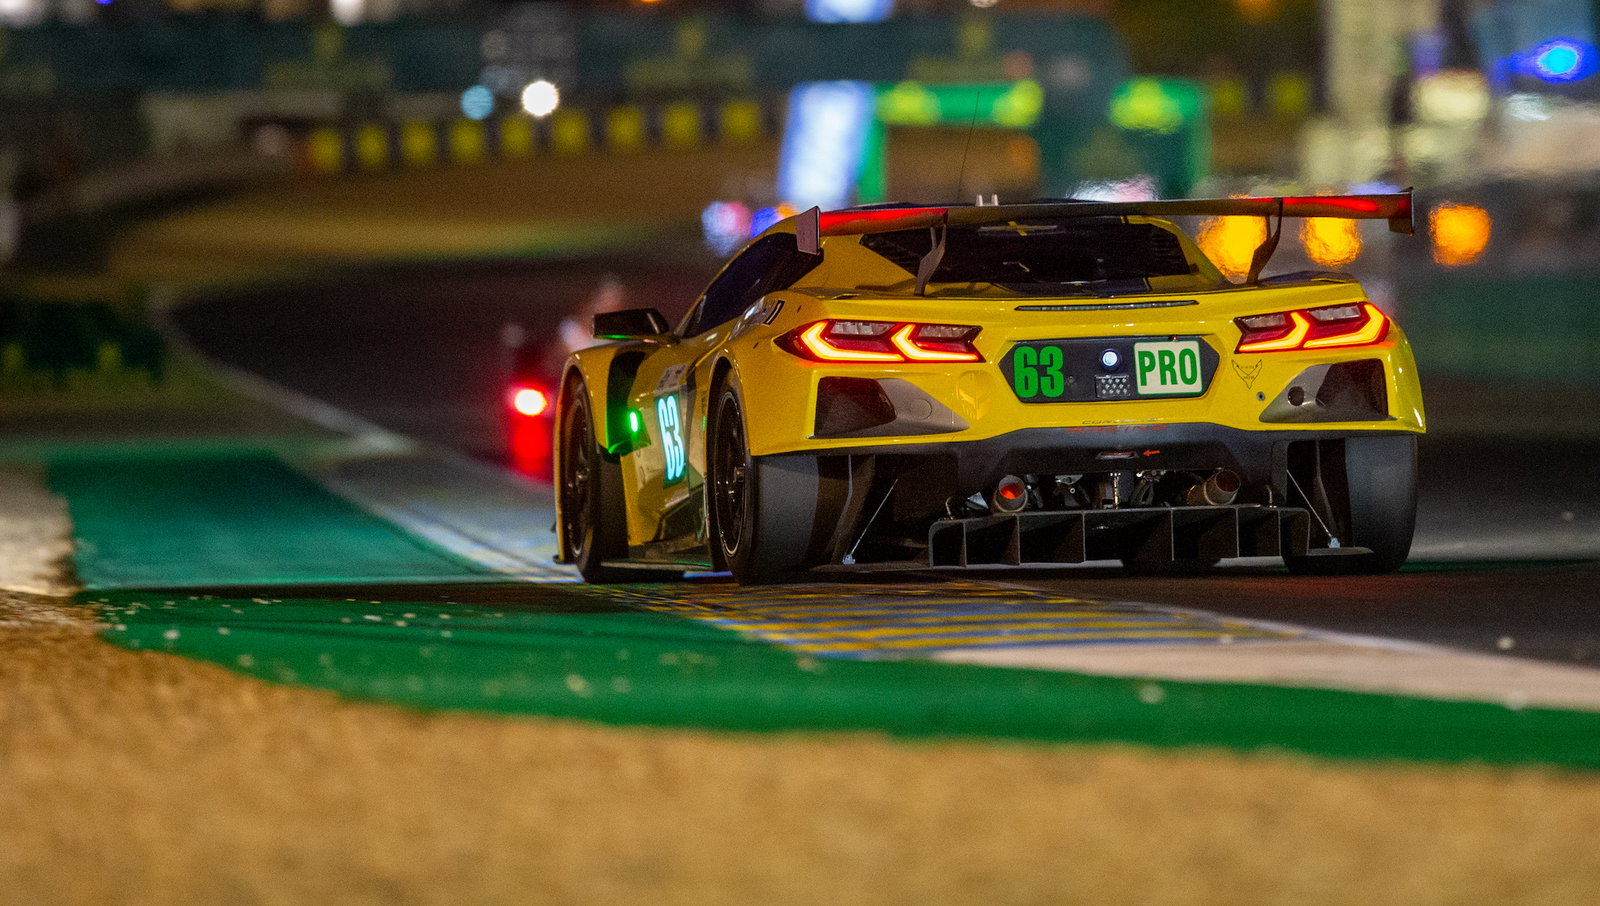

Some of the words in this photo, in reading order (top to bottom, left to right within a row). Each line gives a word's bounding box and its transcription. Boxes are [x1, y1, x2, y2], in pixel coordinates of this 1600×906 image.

[1013, 346, 1065, 398] 63
[1138, 348, 1198, 386] PRO
[658, 395, 685, 480] 63
